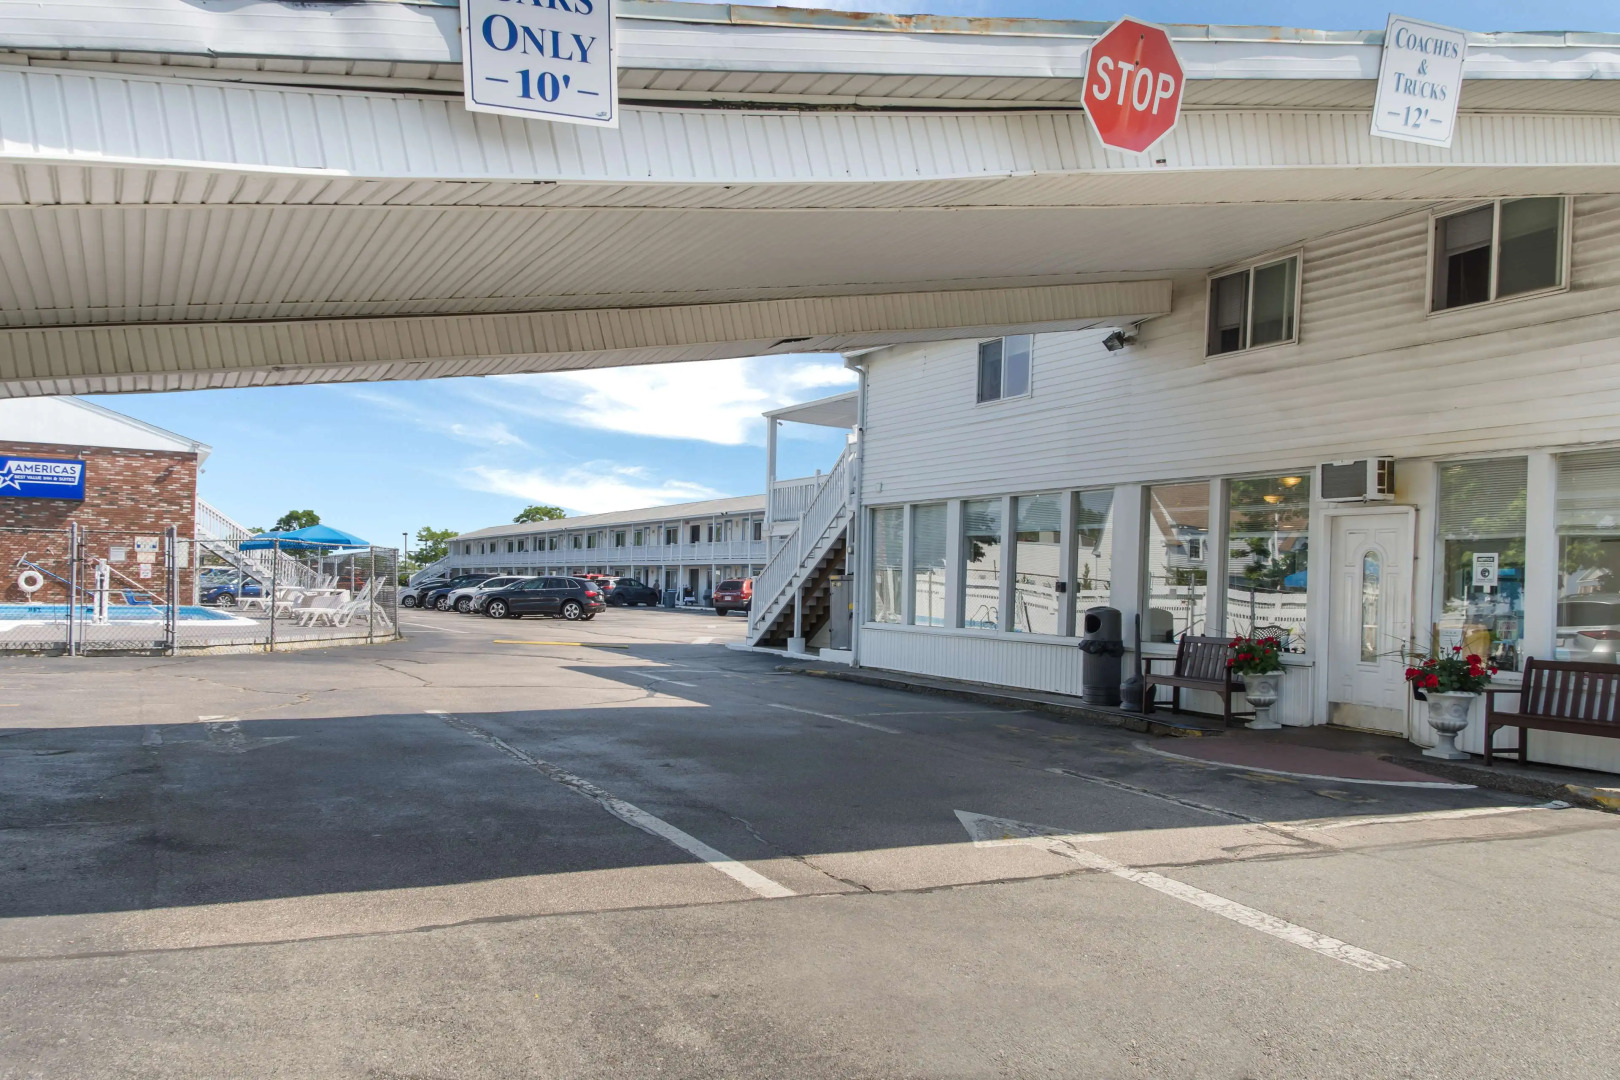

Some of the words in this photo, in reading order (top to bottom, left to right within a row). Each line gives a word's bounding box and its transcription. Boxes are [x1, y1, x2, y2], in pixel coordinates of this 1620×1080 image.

[482, 14, 597, 64] ONLY
[1395, 27, 1459, 59] COACHES
[1417, 58, 1429, 76] &
[1092, 55, 1175, 115] STOP
[1394, 71, 1448, 101] TRUCKS
[15, 464, 76, 474] AMERICAS
